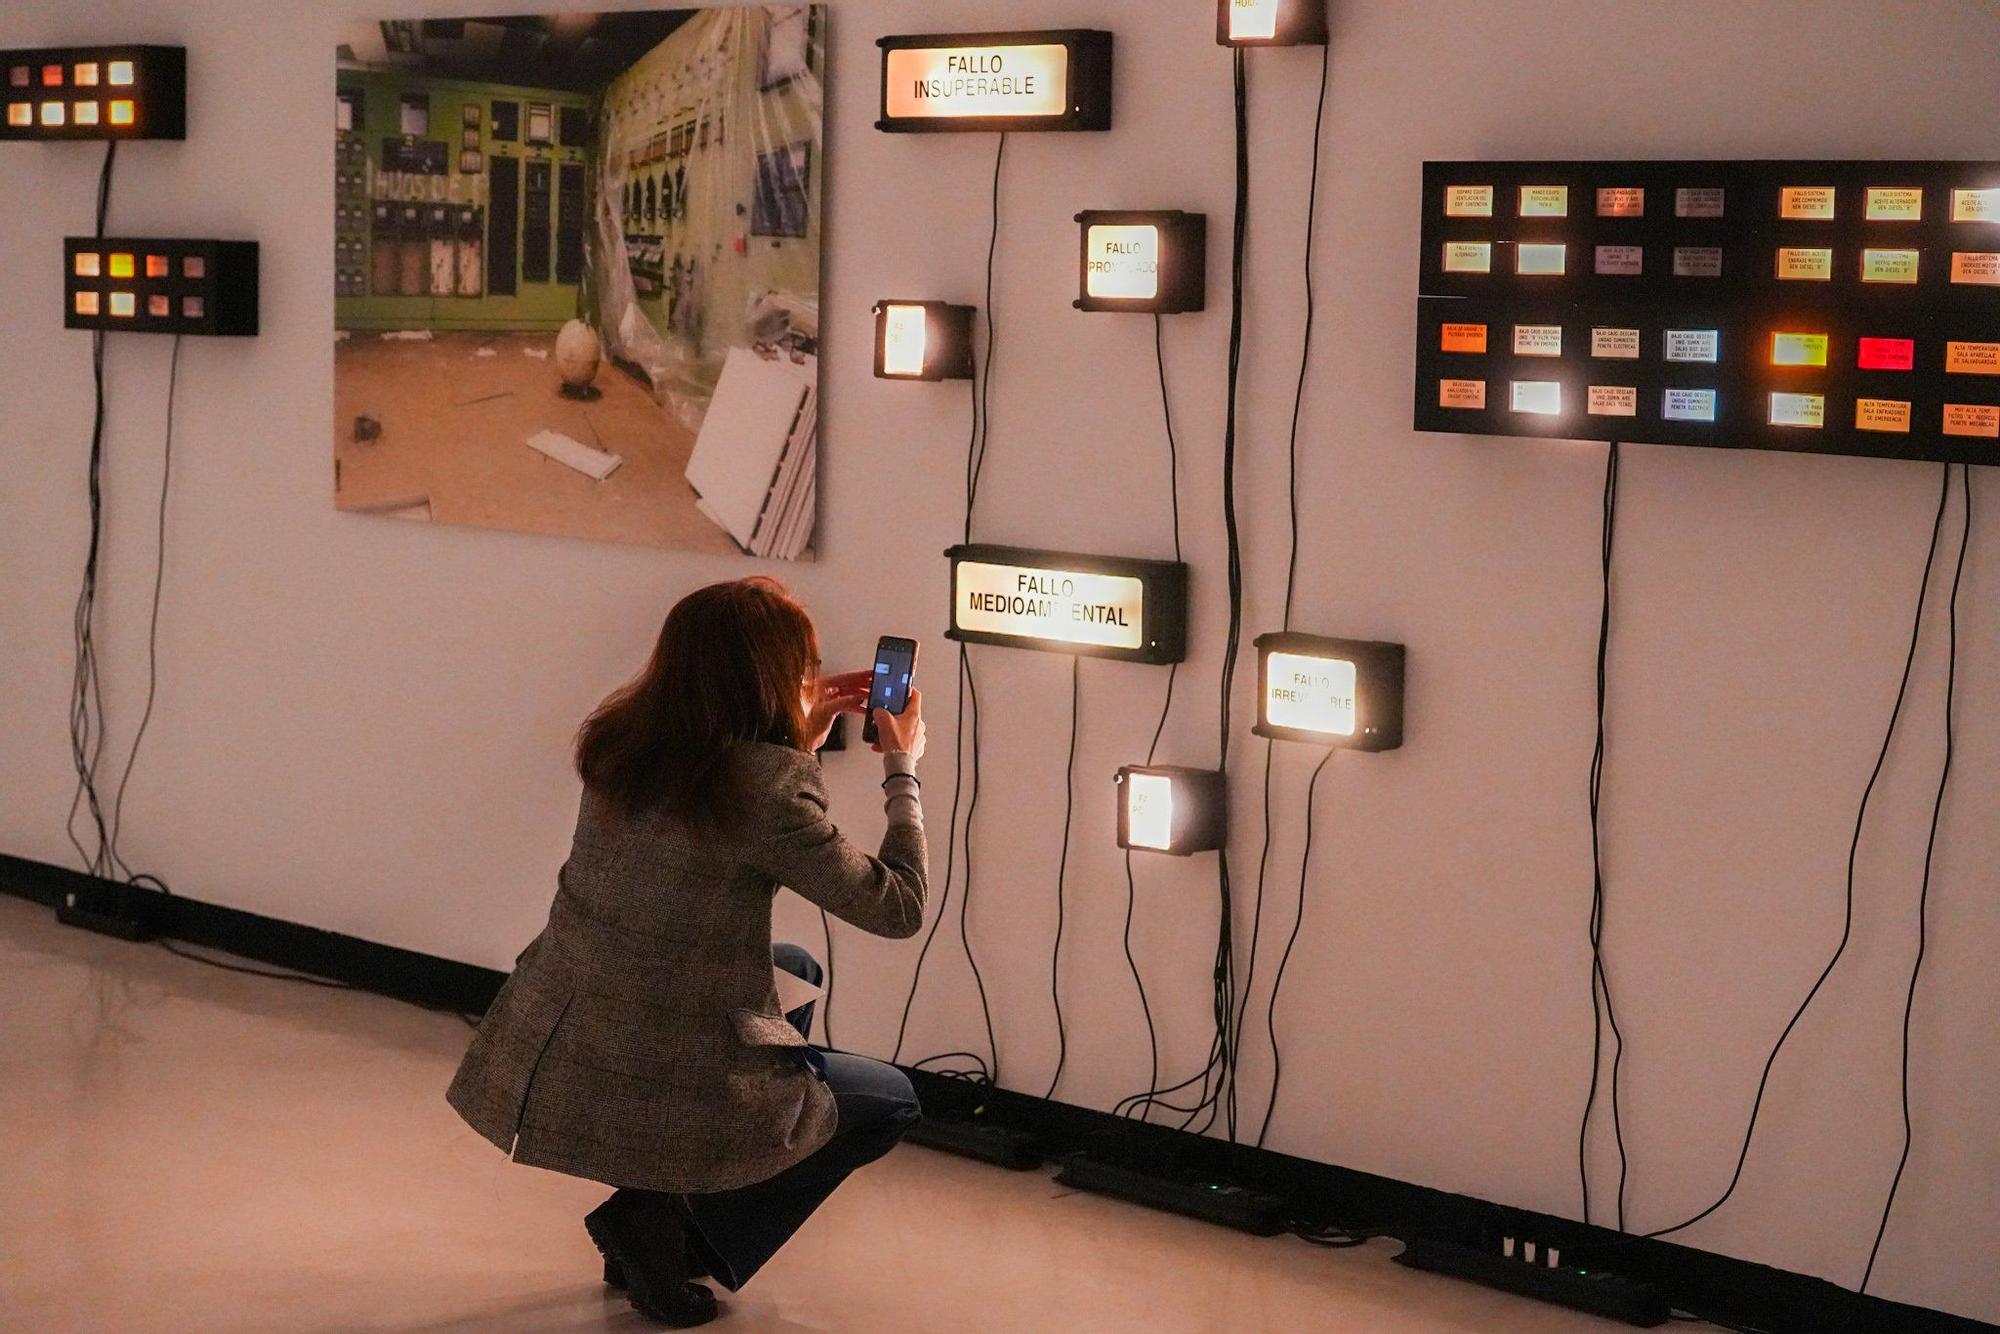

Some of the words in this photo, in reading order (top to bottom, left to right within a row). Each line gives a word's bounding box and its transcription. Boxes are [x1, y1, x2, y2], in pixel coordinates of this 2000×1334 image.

[948, 55, 1003, 73] FALLO
[914, 77, 1035, 98] INSUPERABLE
[1106, 242, 1141, 254] FALLO
[1018, 574, 1074, 597] FALLO
[970, 592, 1129, 626] MEDIOAMENTAL
[1295, 673, 1330, 689] FALLO
